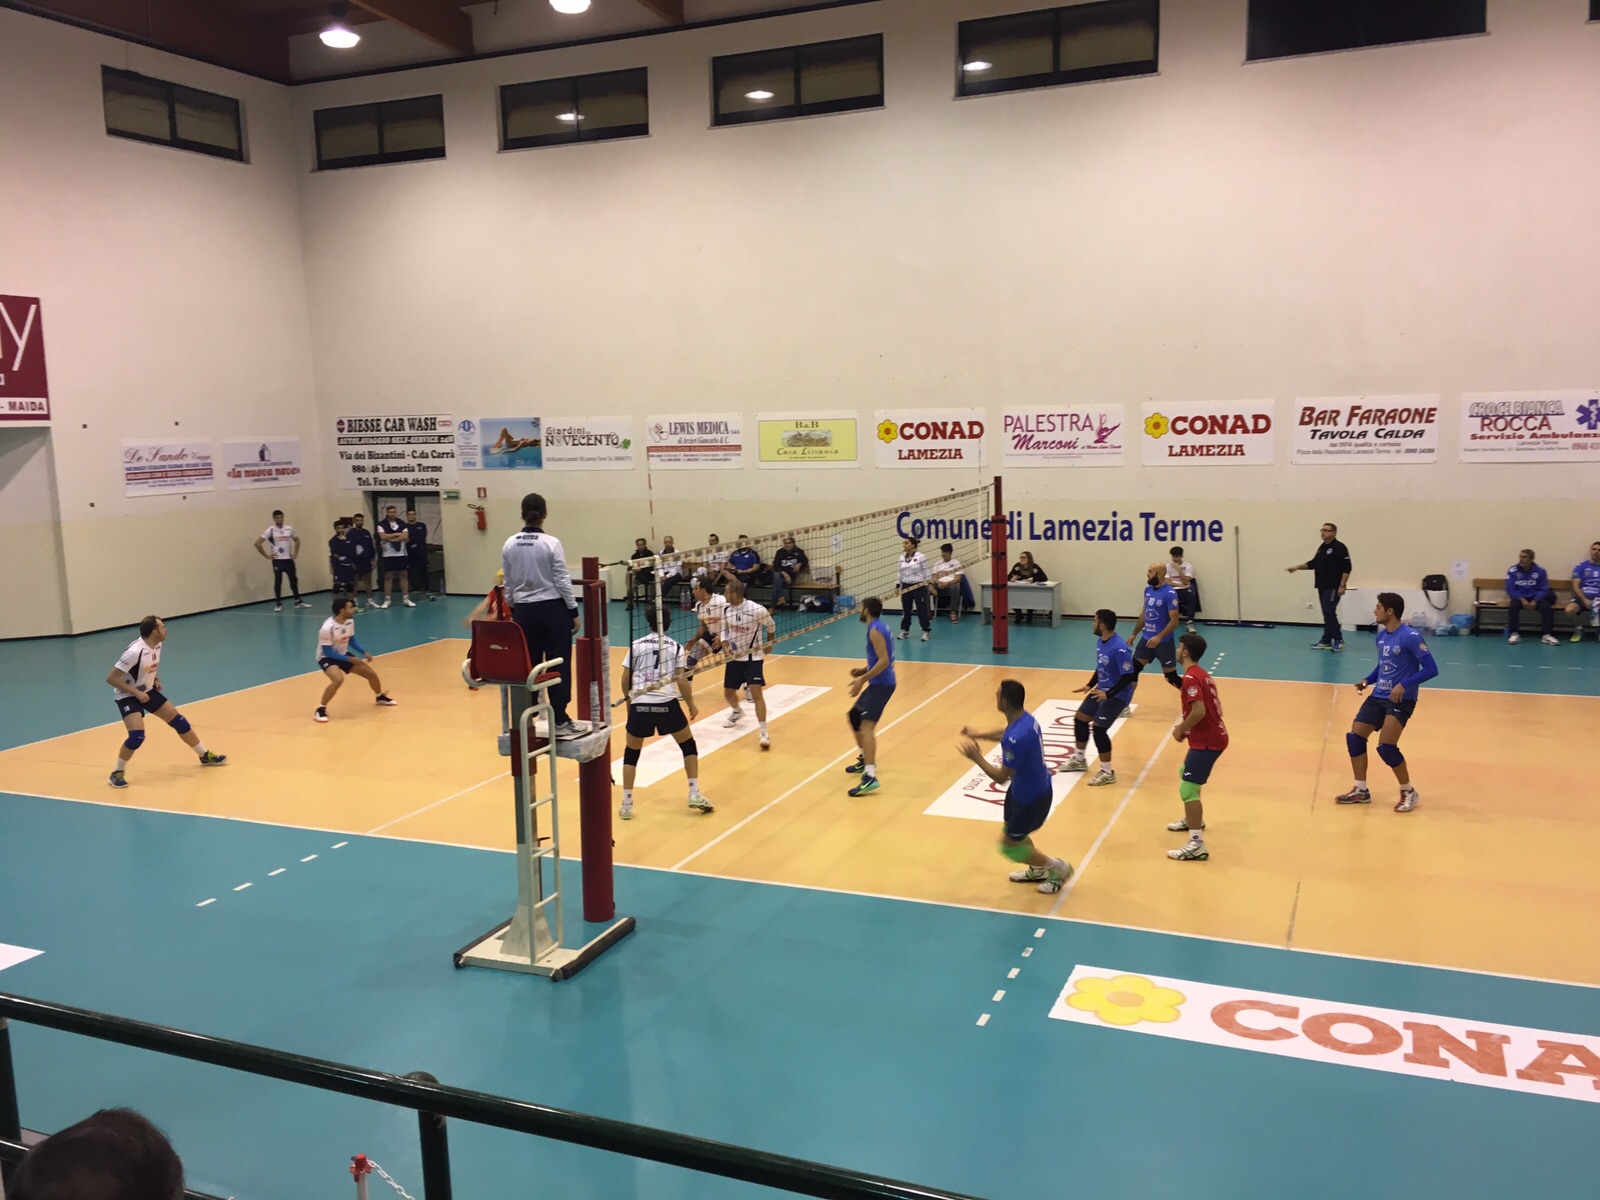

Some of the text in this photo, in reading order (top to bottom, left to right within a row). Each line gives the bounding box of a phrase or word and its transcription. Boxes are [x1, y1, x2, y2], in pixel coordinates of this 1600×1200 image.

[8, 401, 45, 411] MAIDA
[1469, 400, 1563, 415] CROCE BIANCA
[347, 417, 437, 433] BIESSE CAR WASH
[669, 422, 694, 435] LEWIS
[697, 421, 729, 434] MEDICA
[795, 421, 819, 429] B&B
[899, 421, 984, 440] CONAD
[1004, 414, 1094, 433] PALESTRA
[1171, 414, 1271, 435] CONAD
[1480, 416, 1552, 431] ROCCA
[1012, 434, 1079, 450] Marconi
[1530, 431, 1600, 439] Ambulanz
[339, 451, 353, 460] Via
[354, 451, 366, 460] dei
[368, 450, 405, 459] Bizantini
[412, 449, 429, 459] C.da
[431, 449, 455, 458] Carrà
[898, 449, 963, 460] LAMEZIA
[1168, 445, 1245, 457] LAMEZIA
[382, 464, 415, 473] Lamezia
[417, 464, 443, 472] Terme
[374, 477, 388, 486] Fax
[897, 511, 991, 540] Comune
[1030, 511, 1133, 541] Lamezia
[1139, 512, 1223, 542] Terme
[1383, 645, 1390, 656] 12
[653, 650, 660, 669] 7
